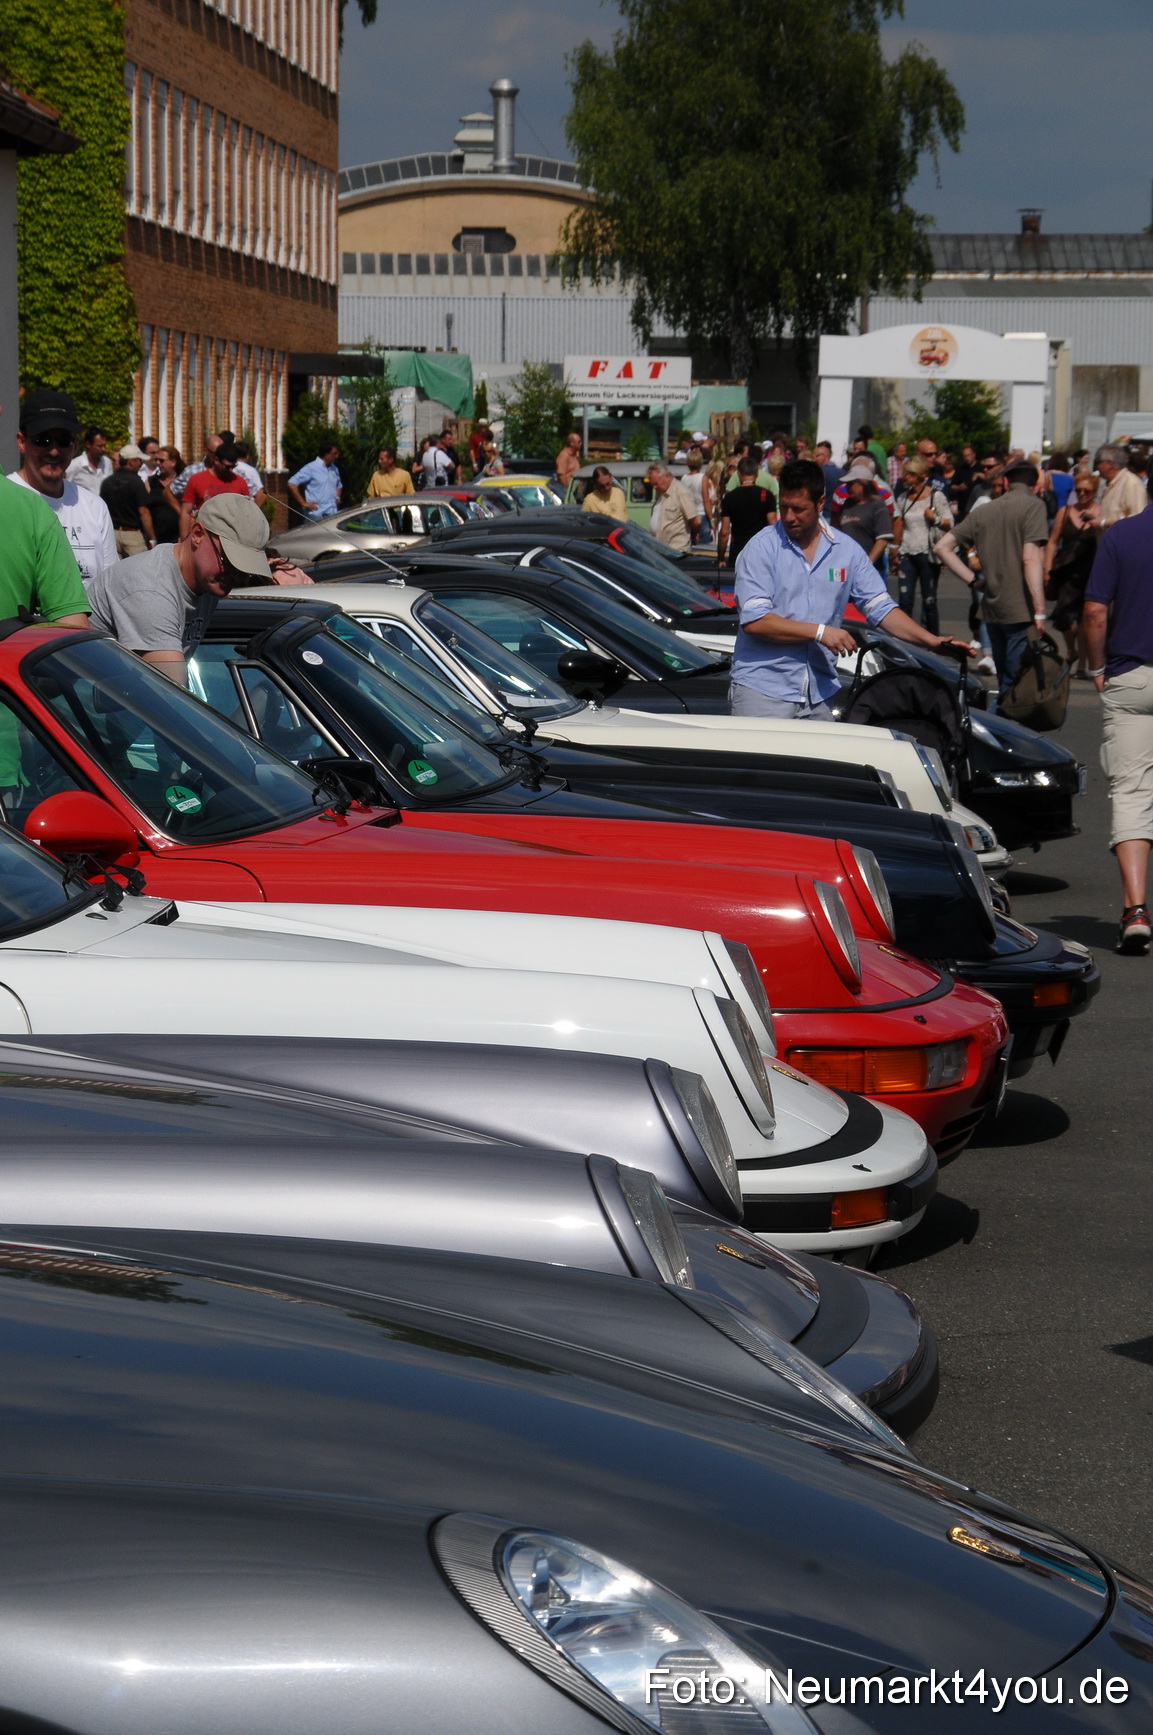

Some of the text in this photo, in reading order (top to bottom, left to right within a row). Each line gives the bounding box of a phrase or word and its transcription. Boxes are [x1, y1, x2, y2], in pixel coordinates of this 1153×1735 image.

[616, 391, 689, 401] Lackversiegelung
[413, 760, 426, 773] 4
[173, 787, 187, 800] 4
